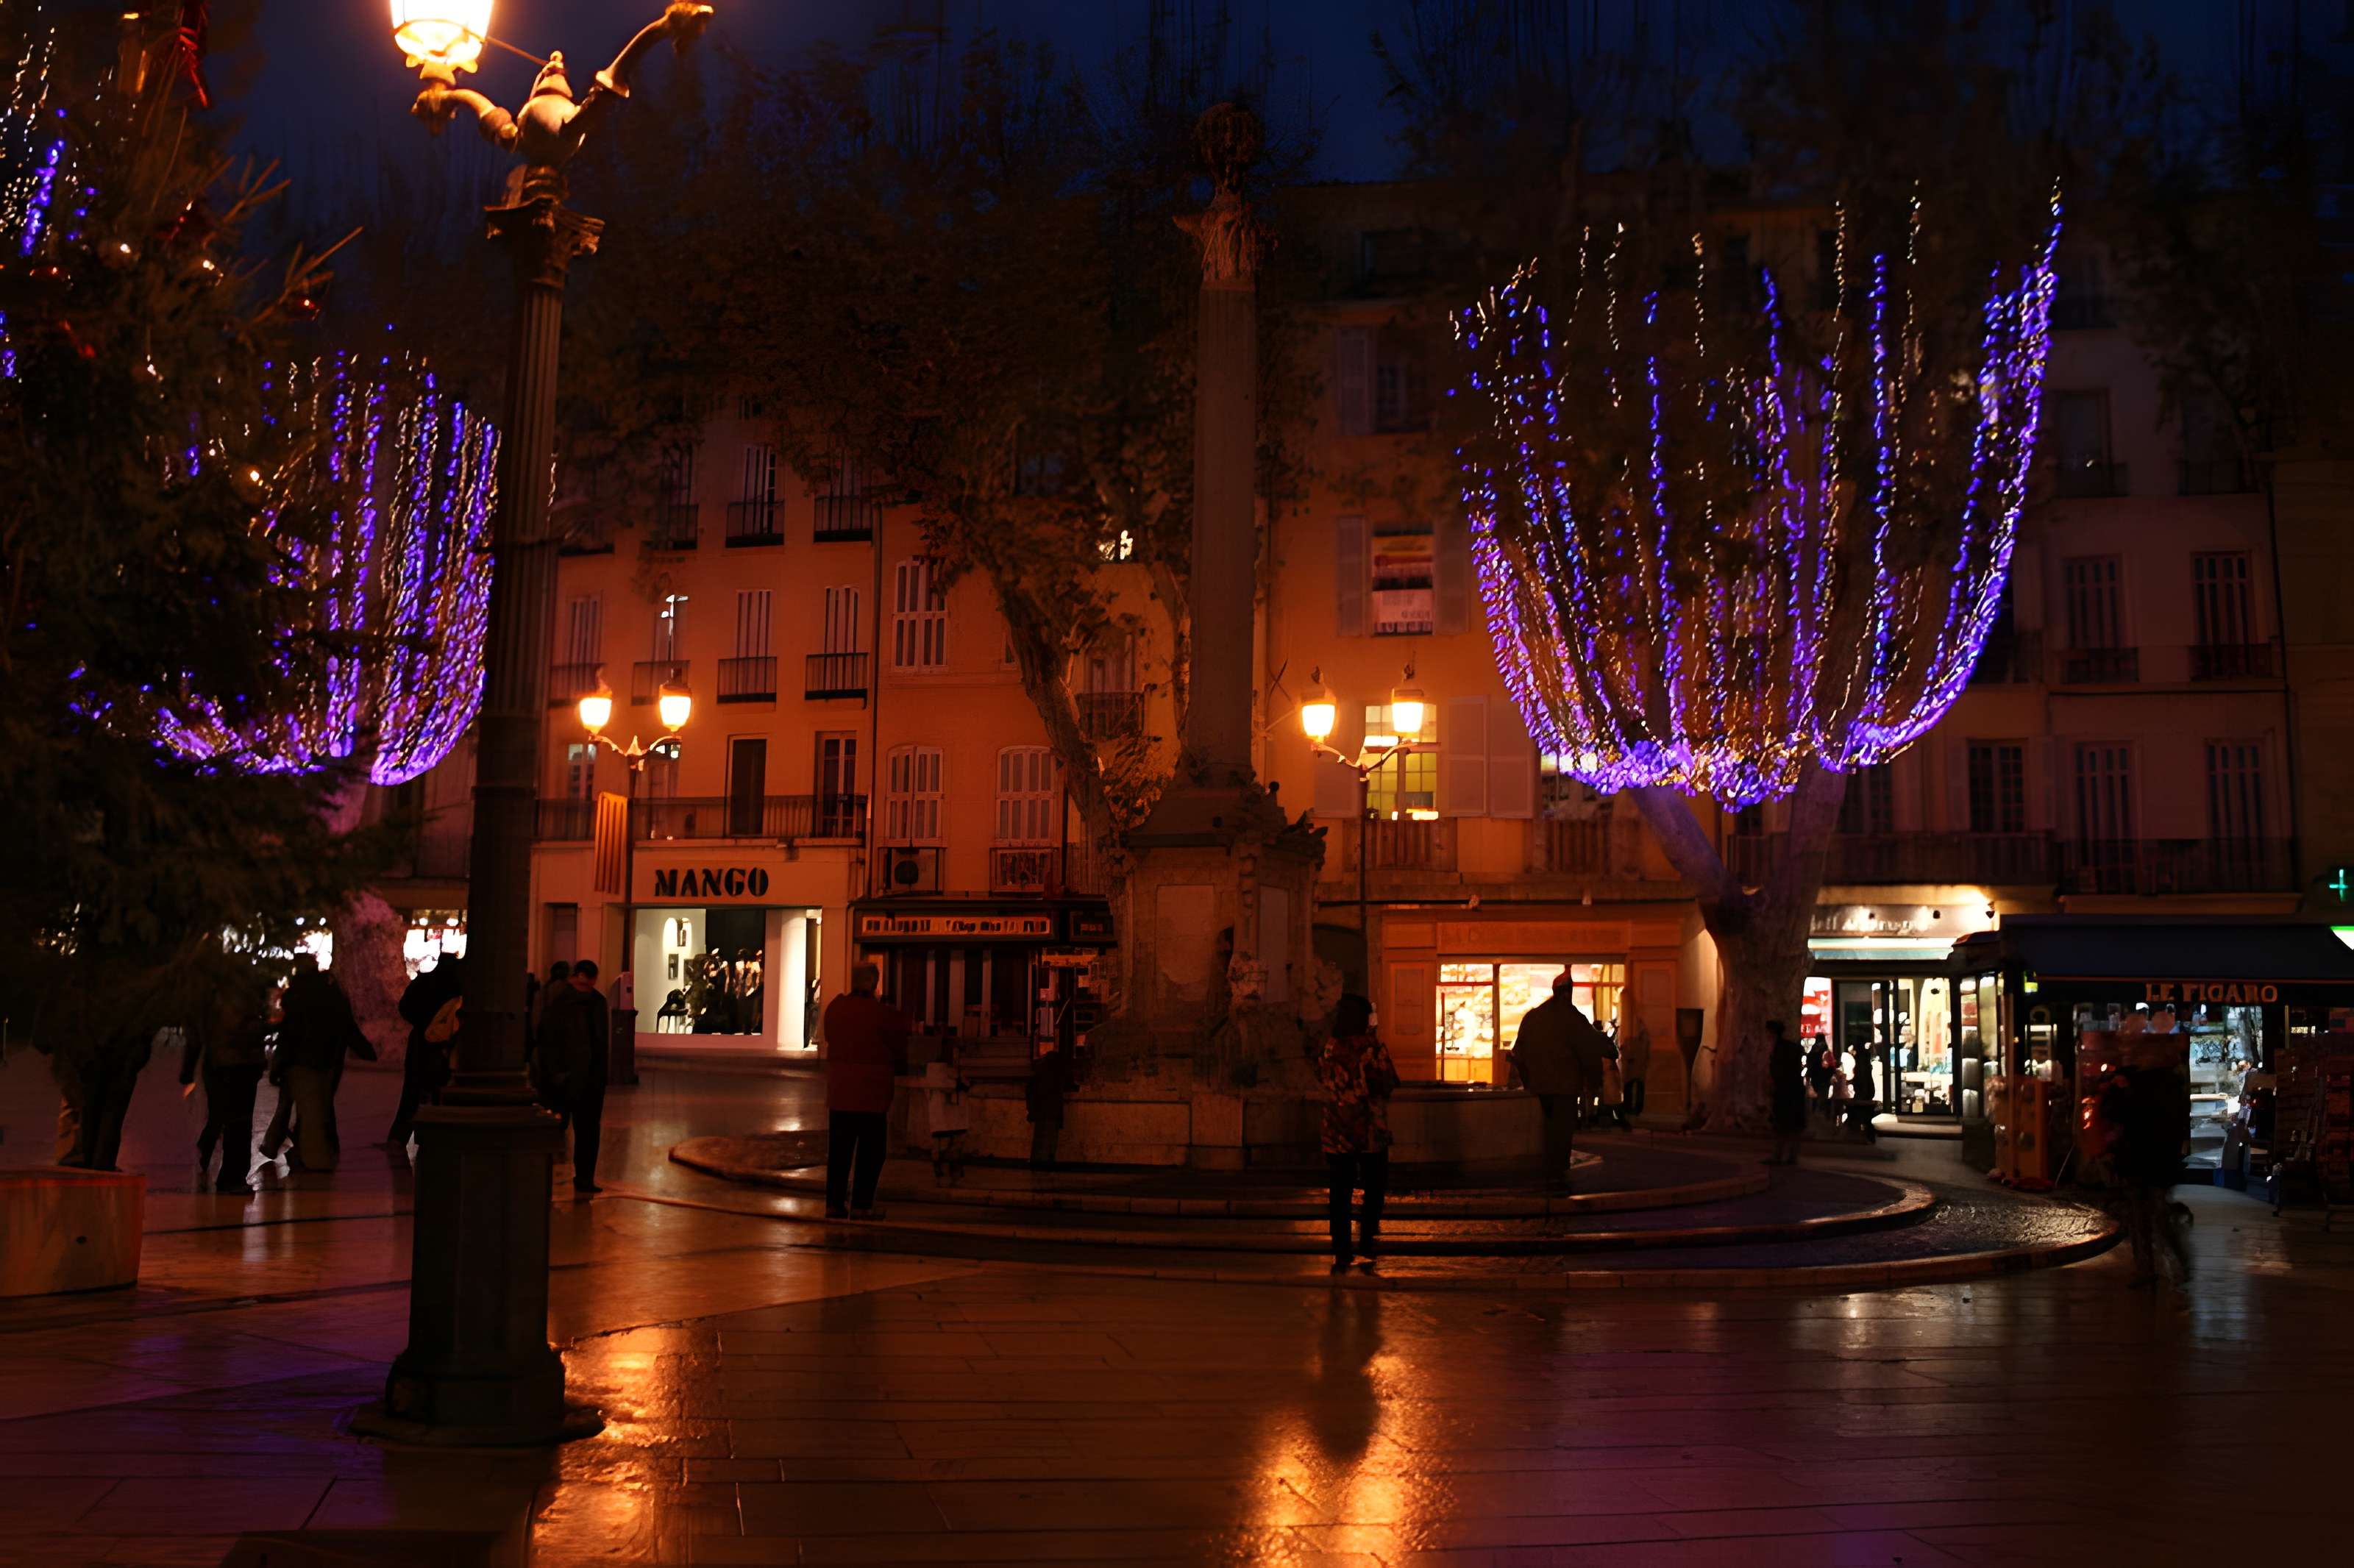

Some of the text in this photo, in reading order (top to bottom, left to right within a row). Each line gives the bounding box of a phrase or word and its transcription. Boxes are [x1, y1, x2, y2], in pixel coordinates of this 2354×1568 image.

[654, 867, 769, 897] MANGO
[2144, 982, 2279, 1004] LE FIGARO
